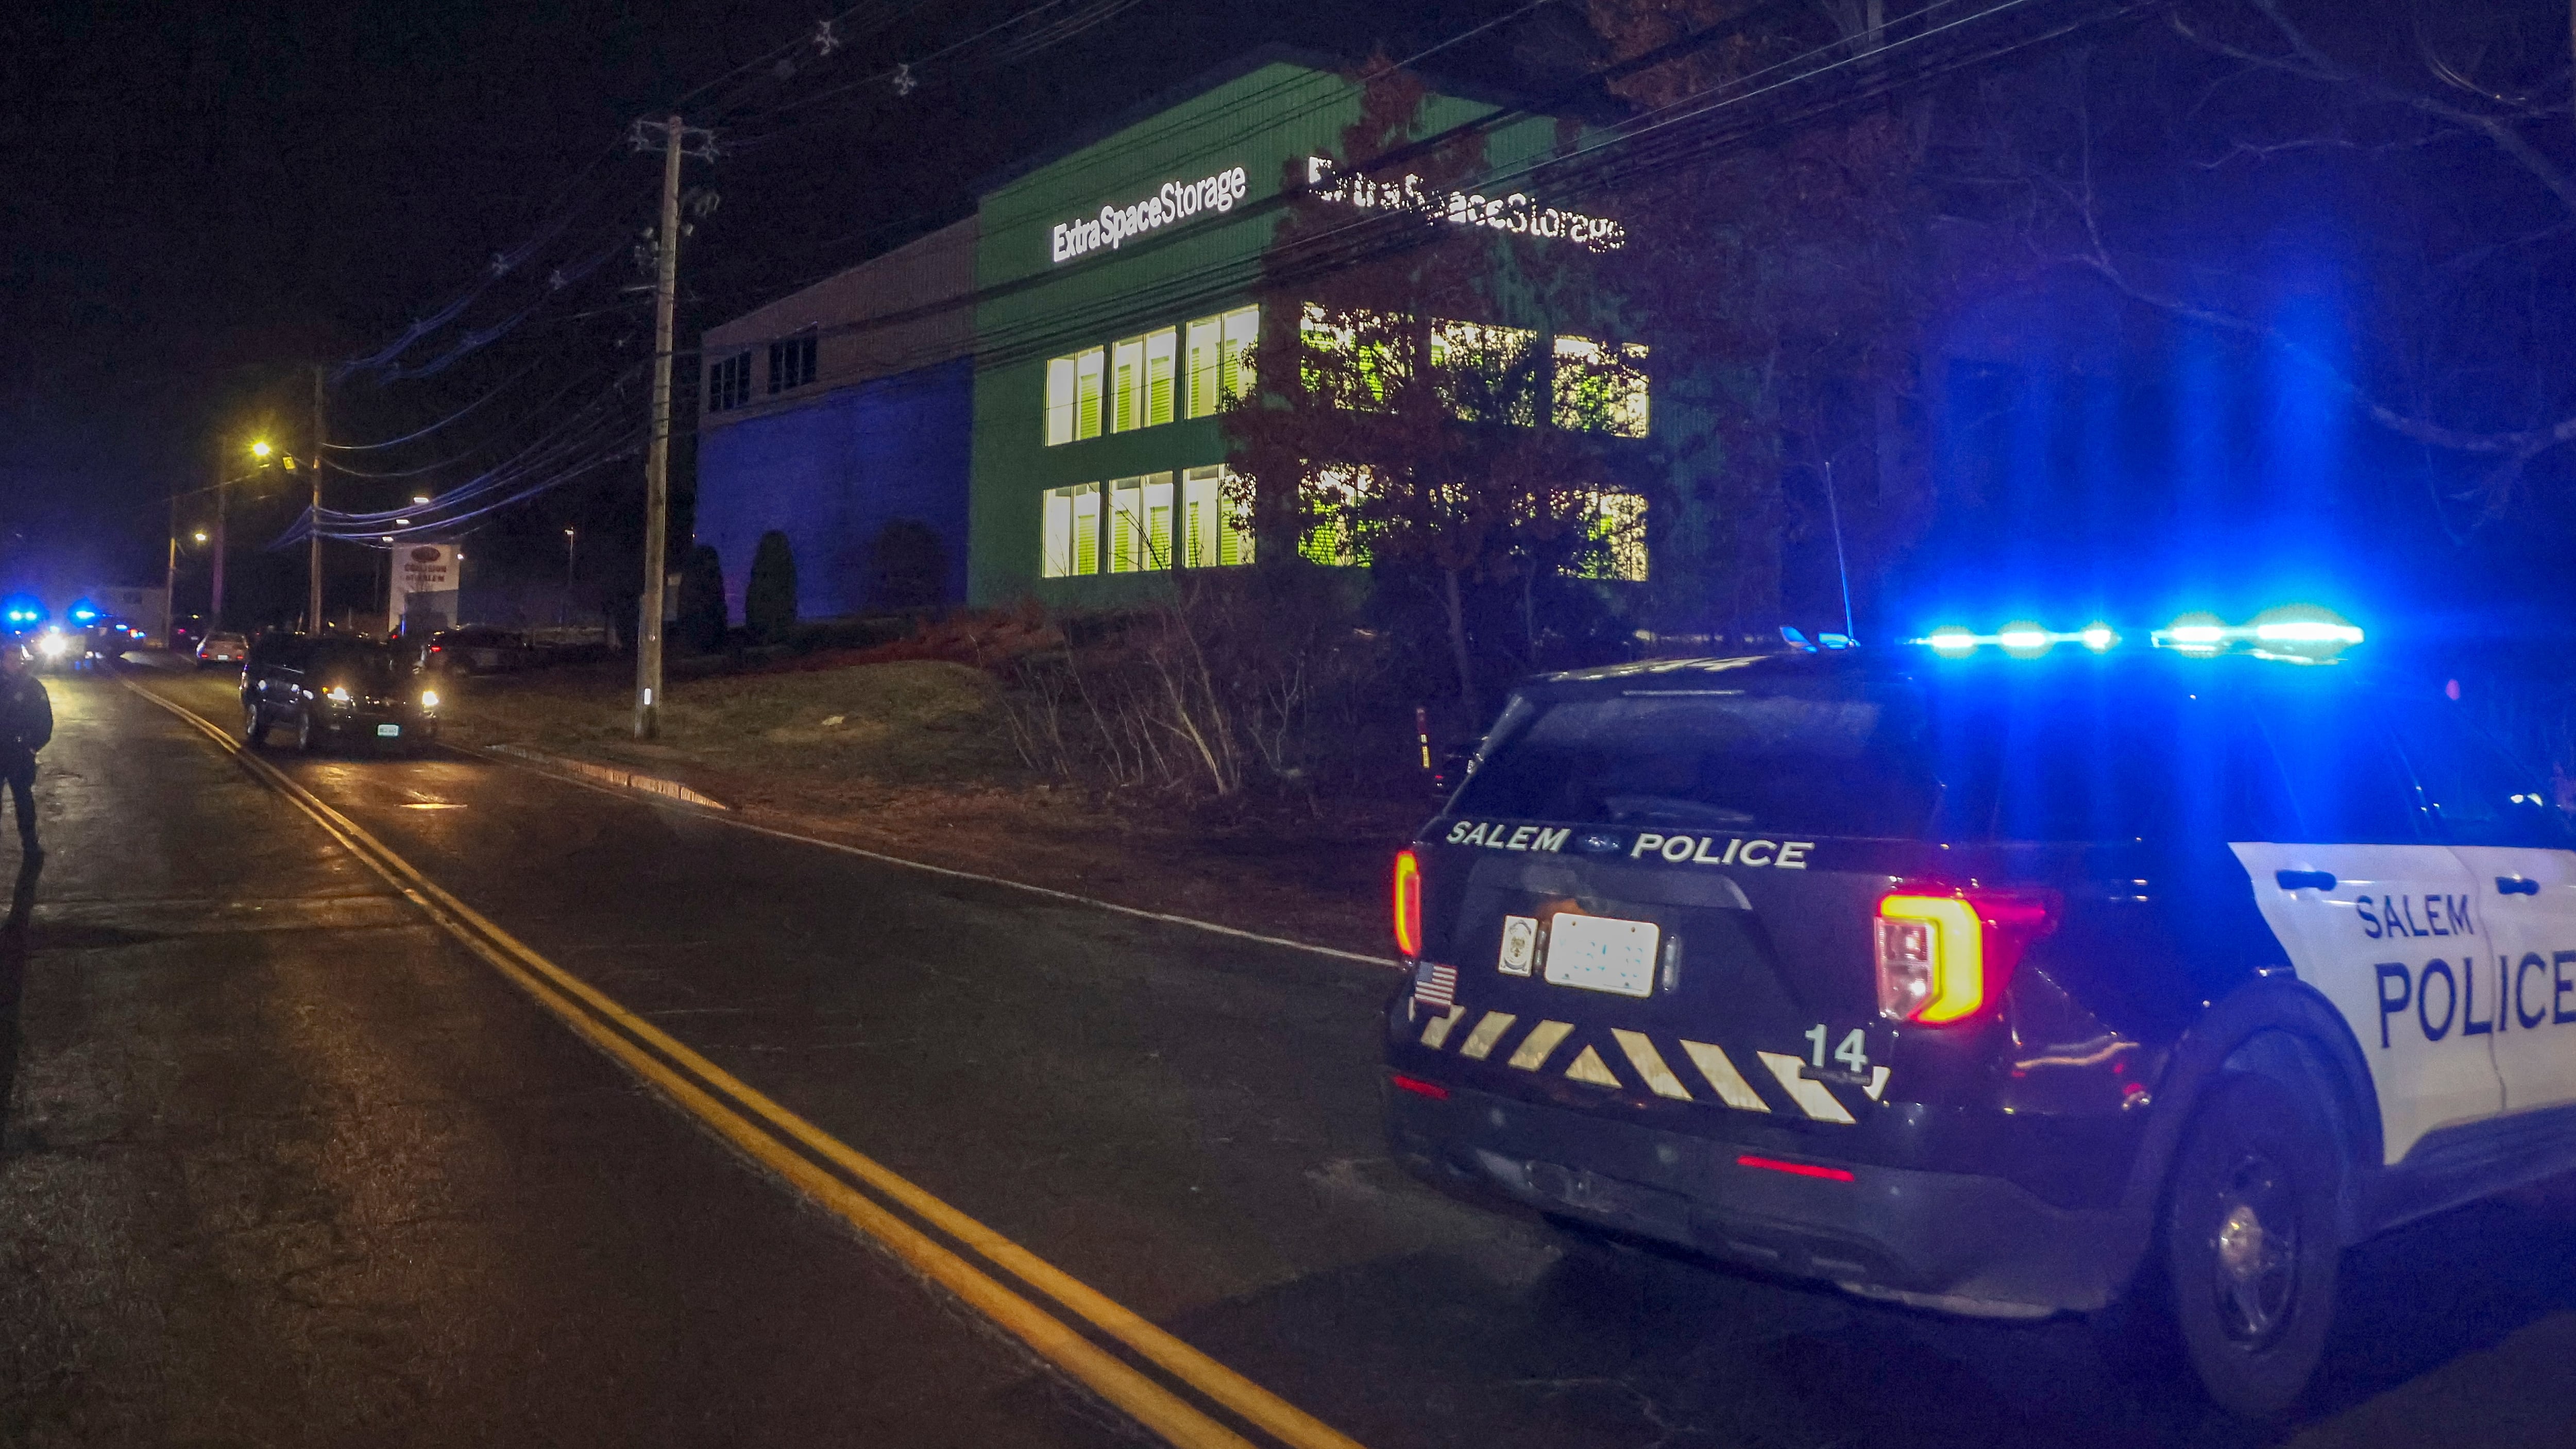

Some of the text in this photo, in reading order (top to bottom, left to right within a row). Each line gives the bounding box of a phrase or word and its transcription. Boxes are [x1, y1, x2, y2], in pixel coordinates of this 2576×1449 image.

[1053, 166, 1246, 263] ExtraSpaceStorage
[1446, 821, 1815, 870] SALEM POLICE
[2357, 894, 2474, 939] SALEM
[2375, 951, 2576, 1049] POLICE
[1805, 1023, 1868, 1072] 14
